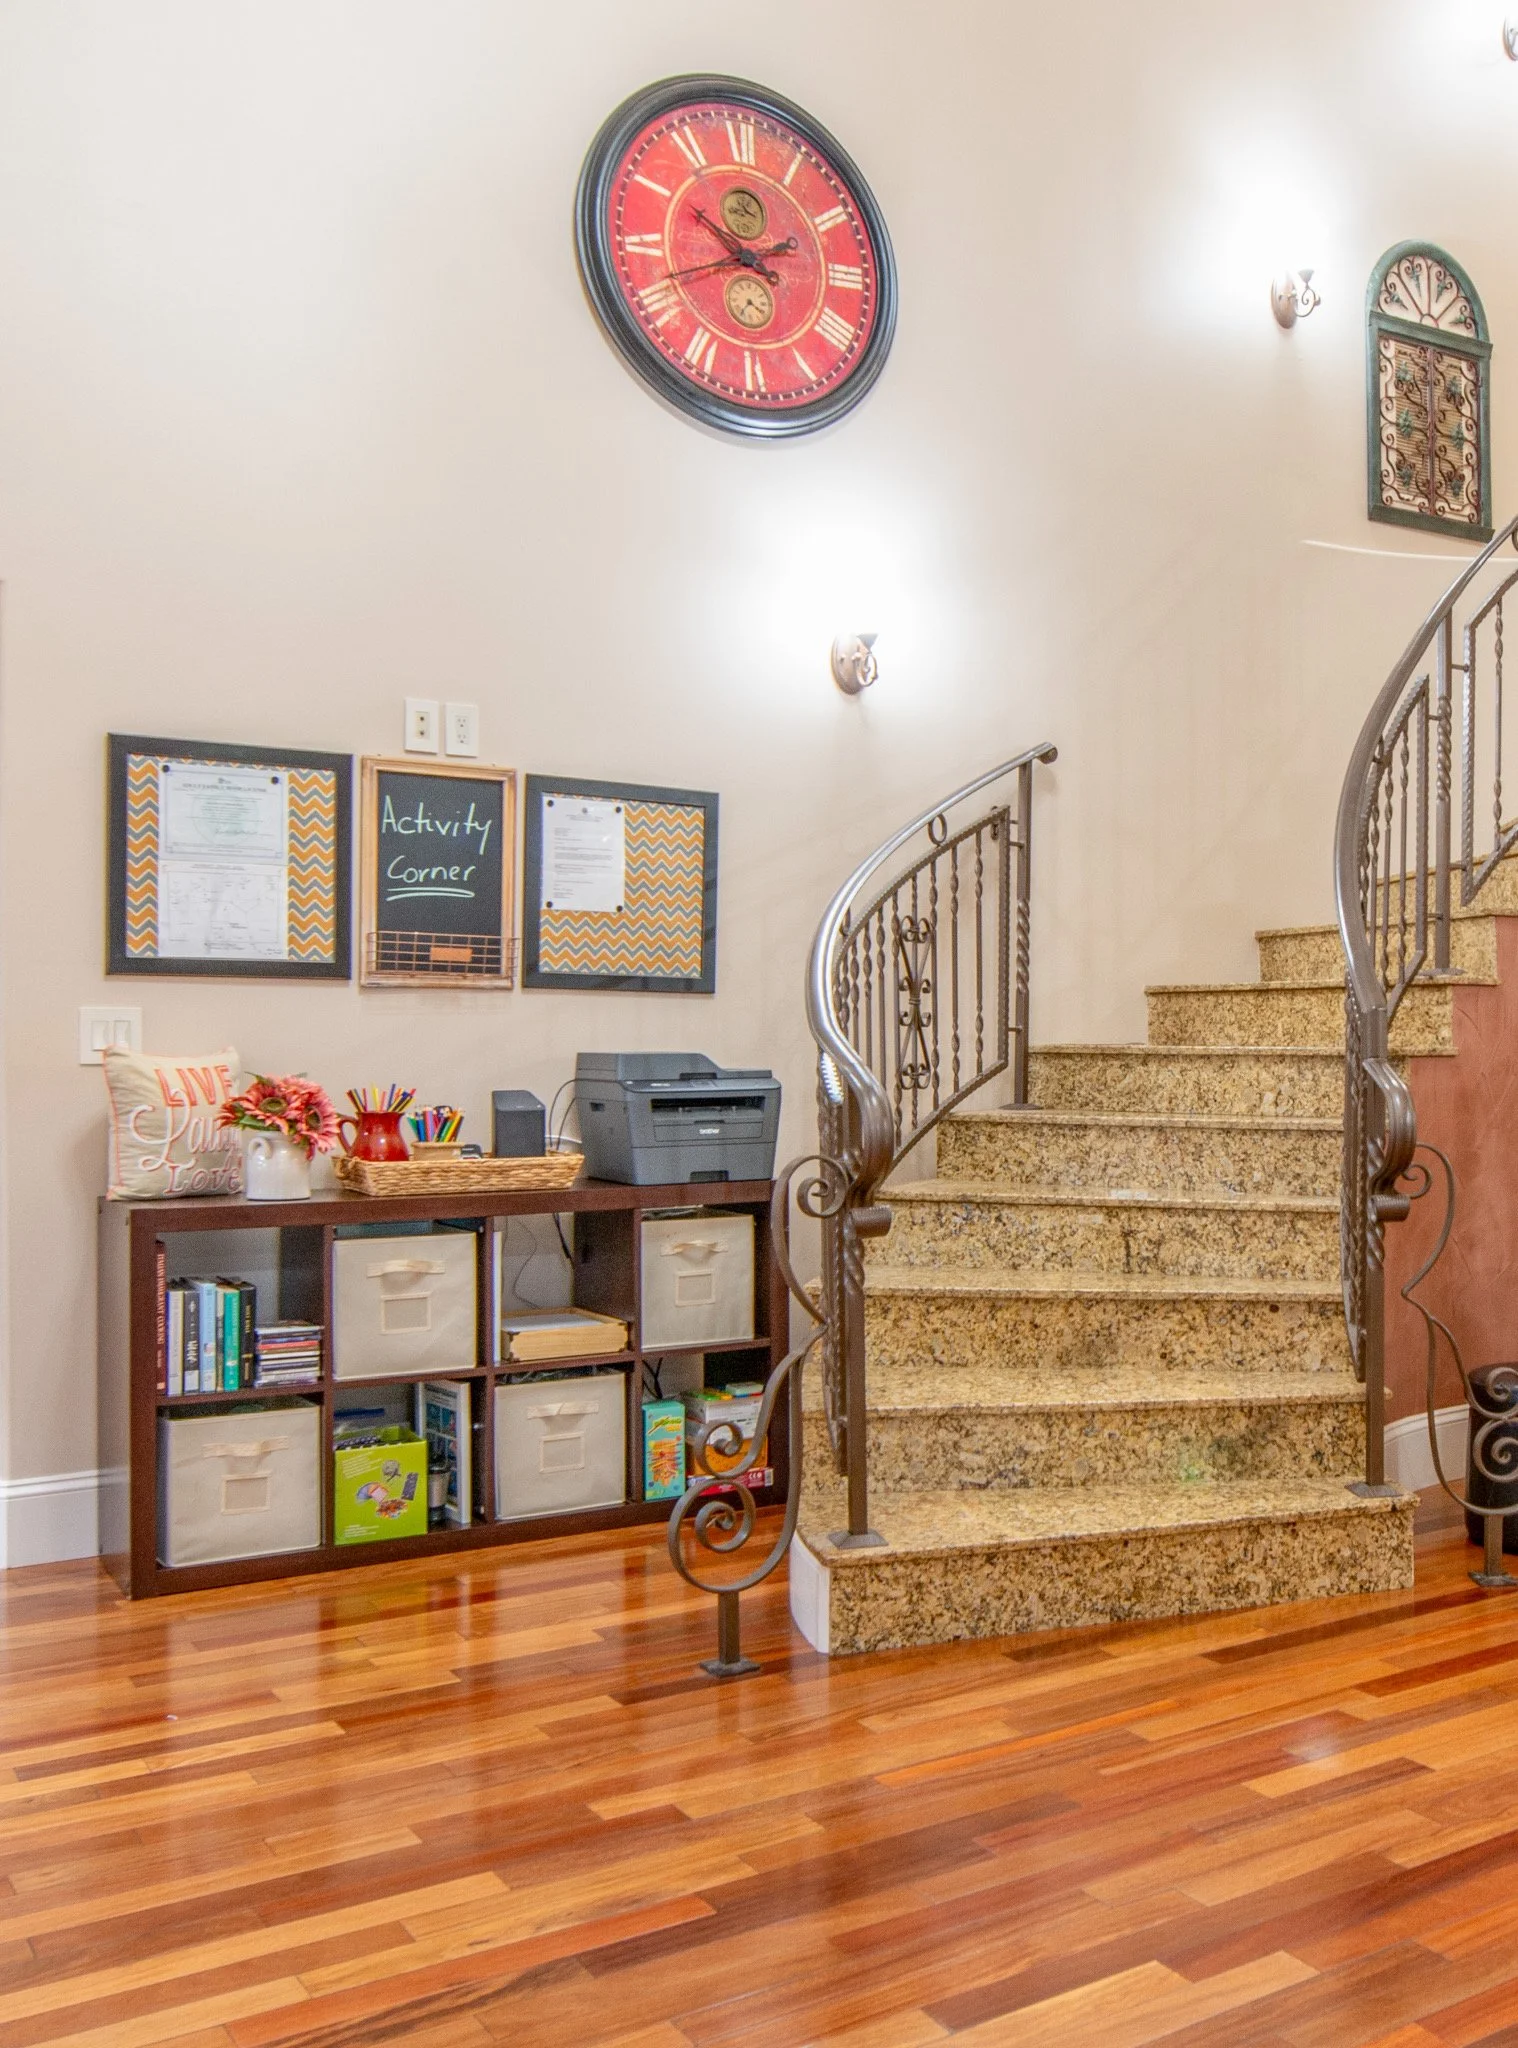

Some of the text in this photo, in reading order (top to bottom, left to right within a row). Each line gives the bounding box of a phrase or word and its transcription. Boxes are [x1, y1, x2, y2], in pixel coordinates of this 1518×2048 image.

[381, 795, 492, 855] Activity
[387, 856, 476, 883] Corner
[154, 1064, 233, 1108] LIVE
